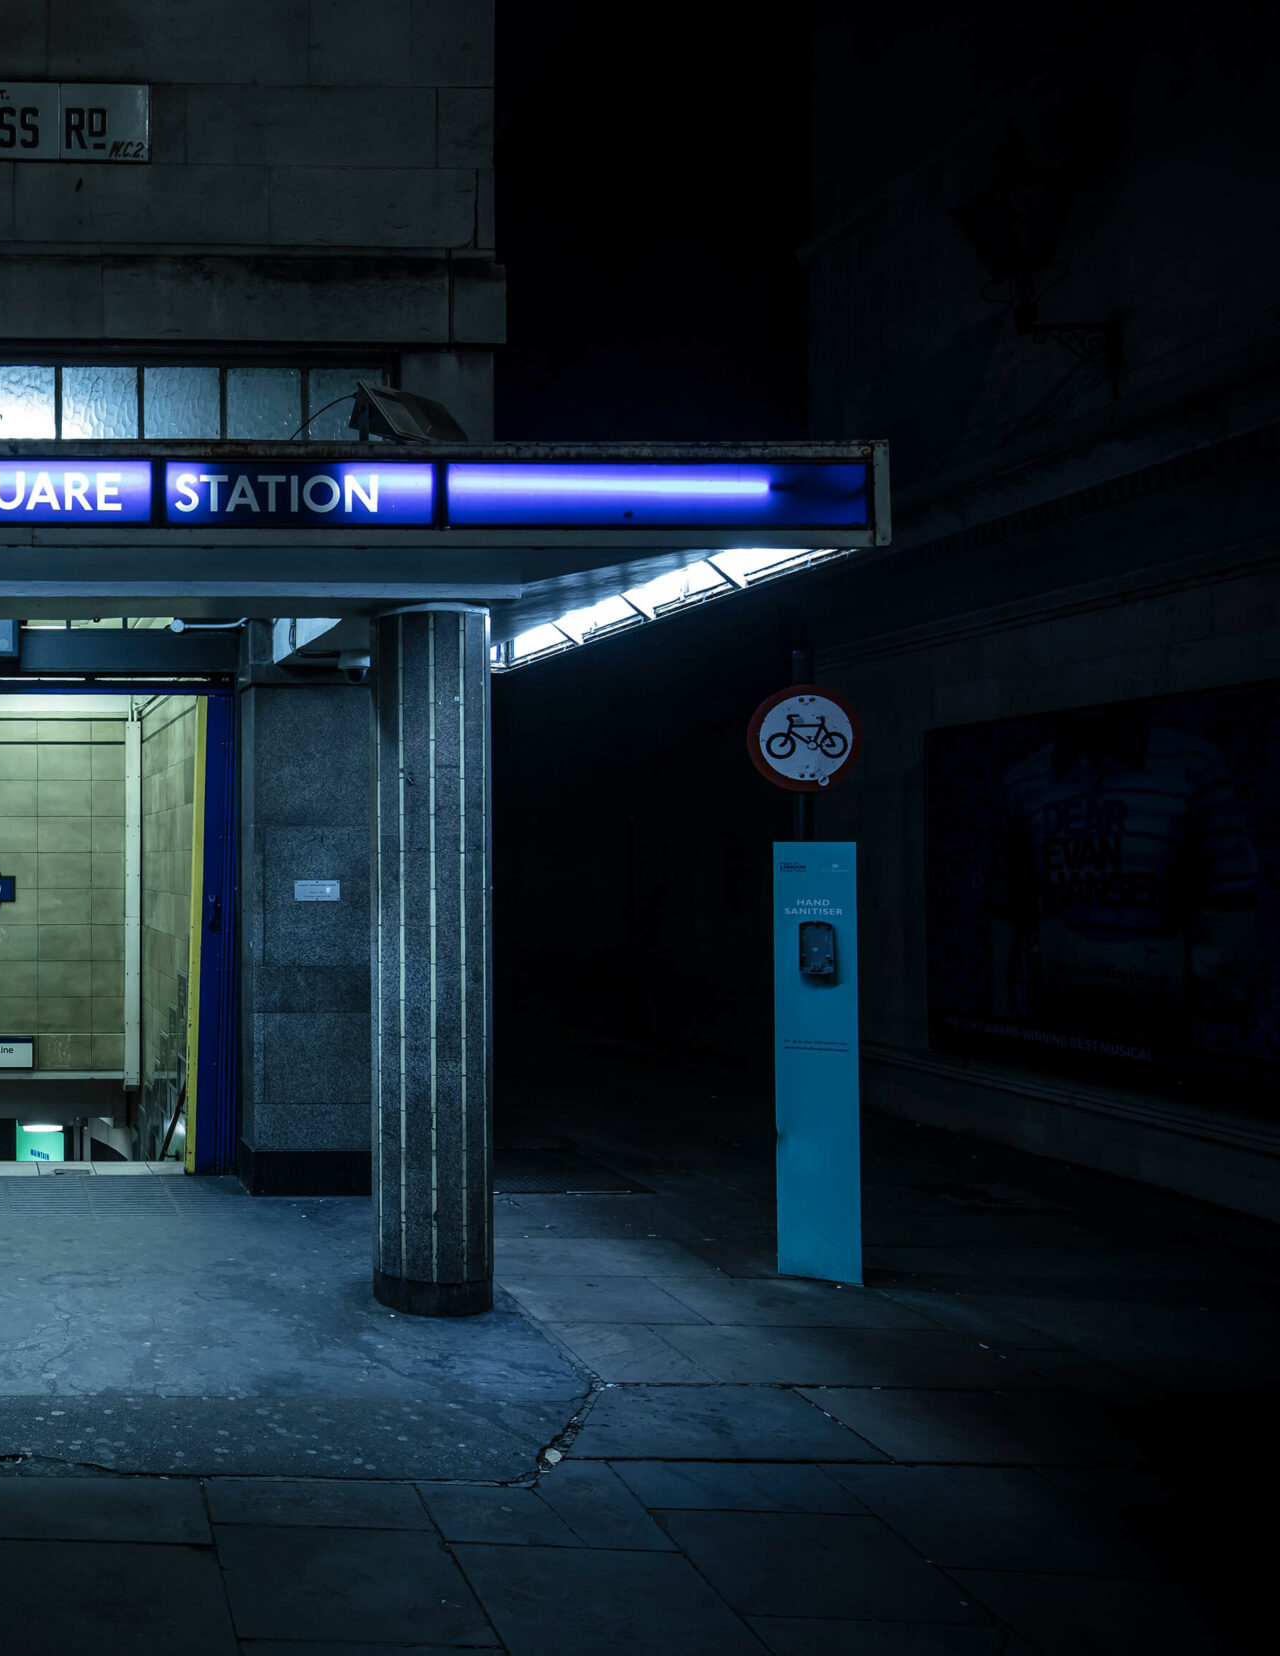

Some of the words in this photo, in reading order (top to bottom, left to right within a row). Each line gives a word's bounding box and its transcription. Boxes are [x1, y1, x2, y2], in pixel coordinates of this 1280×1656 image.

[174, 473, 379, 514] STATION
[1044, 837, 1122, 869] EVAN
[784, 907, 843, 916] SANITISER
[796, 898, 831, 907] HAND
[1100, 1040, 1153, 1063] MUSICAL
